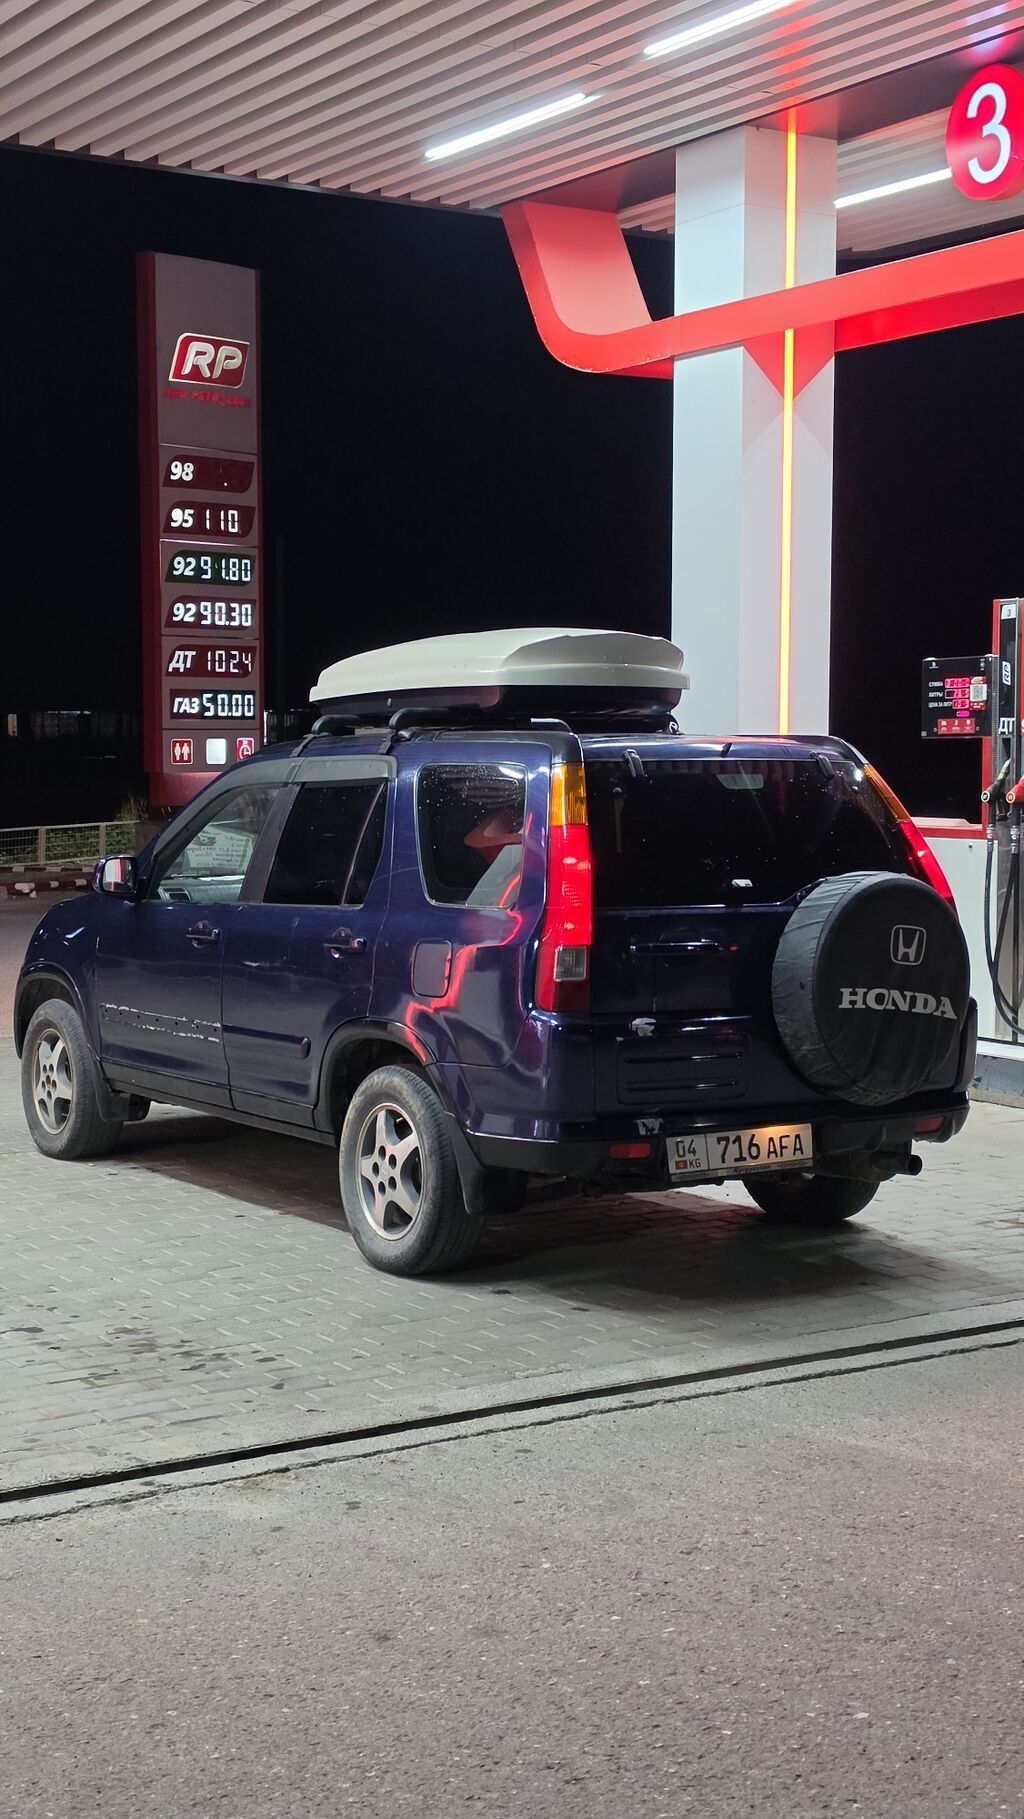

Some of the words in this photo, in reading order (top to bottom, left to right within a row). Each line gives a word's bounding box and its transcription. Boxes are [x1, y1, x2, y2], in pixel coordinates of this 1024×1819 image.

[966, 82, 1011, 184] 3
[180, 341, 243, 379] RP
[170, 461, 194, 481] 98
[170, 508, 194, 528] 95
[172, 556, 196, 576] 92
[172, 602, 197, 622] 92
[200, 601, 252, 627] 90.30
[168, 650, 196, 672] ДТ
[173, 697, 200, 714] ГАЗ
[203, 693, 254, 717] 50.00
[998, 717, 1015, 735] ДТ
[838, 987, 957, 1020] HONDA
[675, 1138, 697, 1158] 04
[716, 1134, 761, 1164] 716
[767, 1133, 804, 1159] AFA
[688, 1158, 701, 1169] KG
